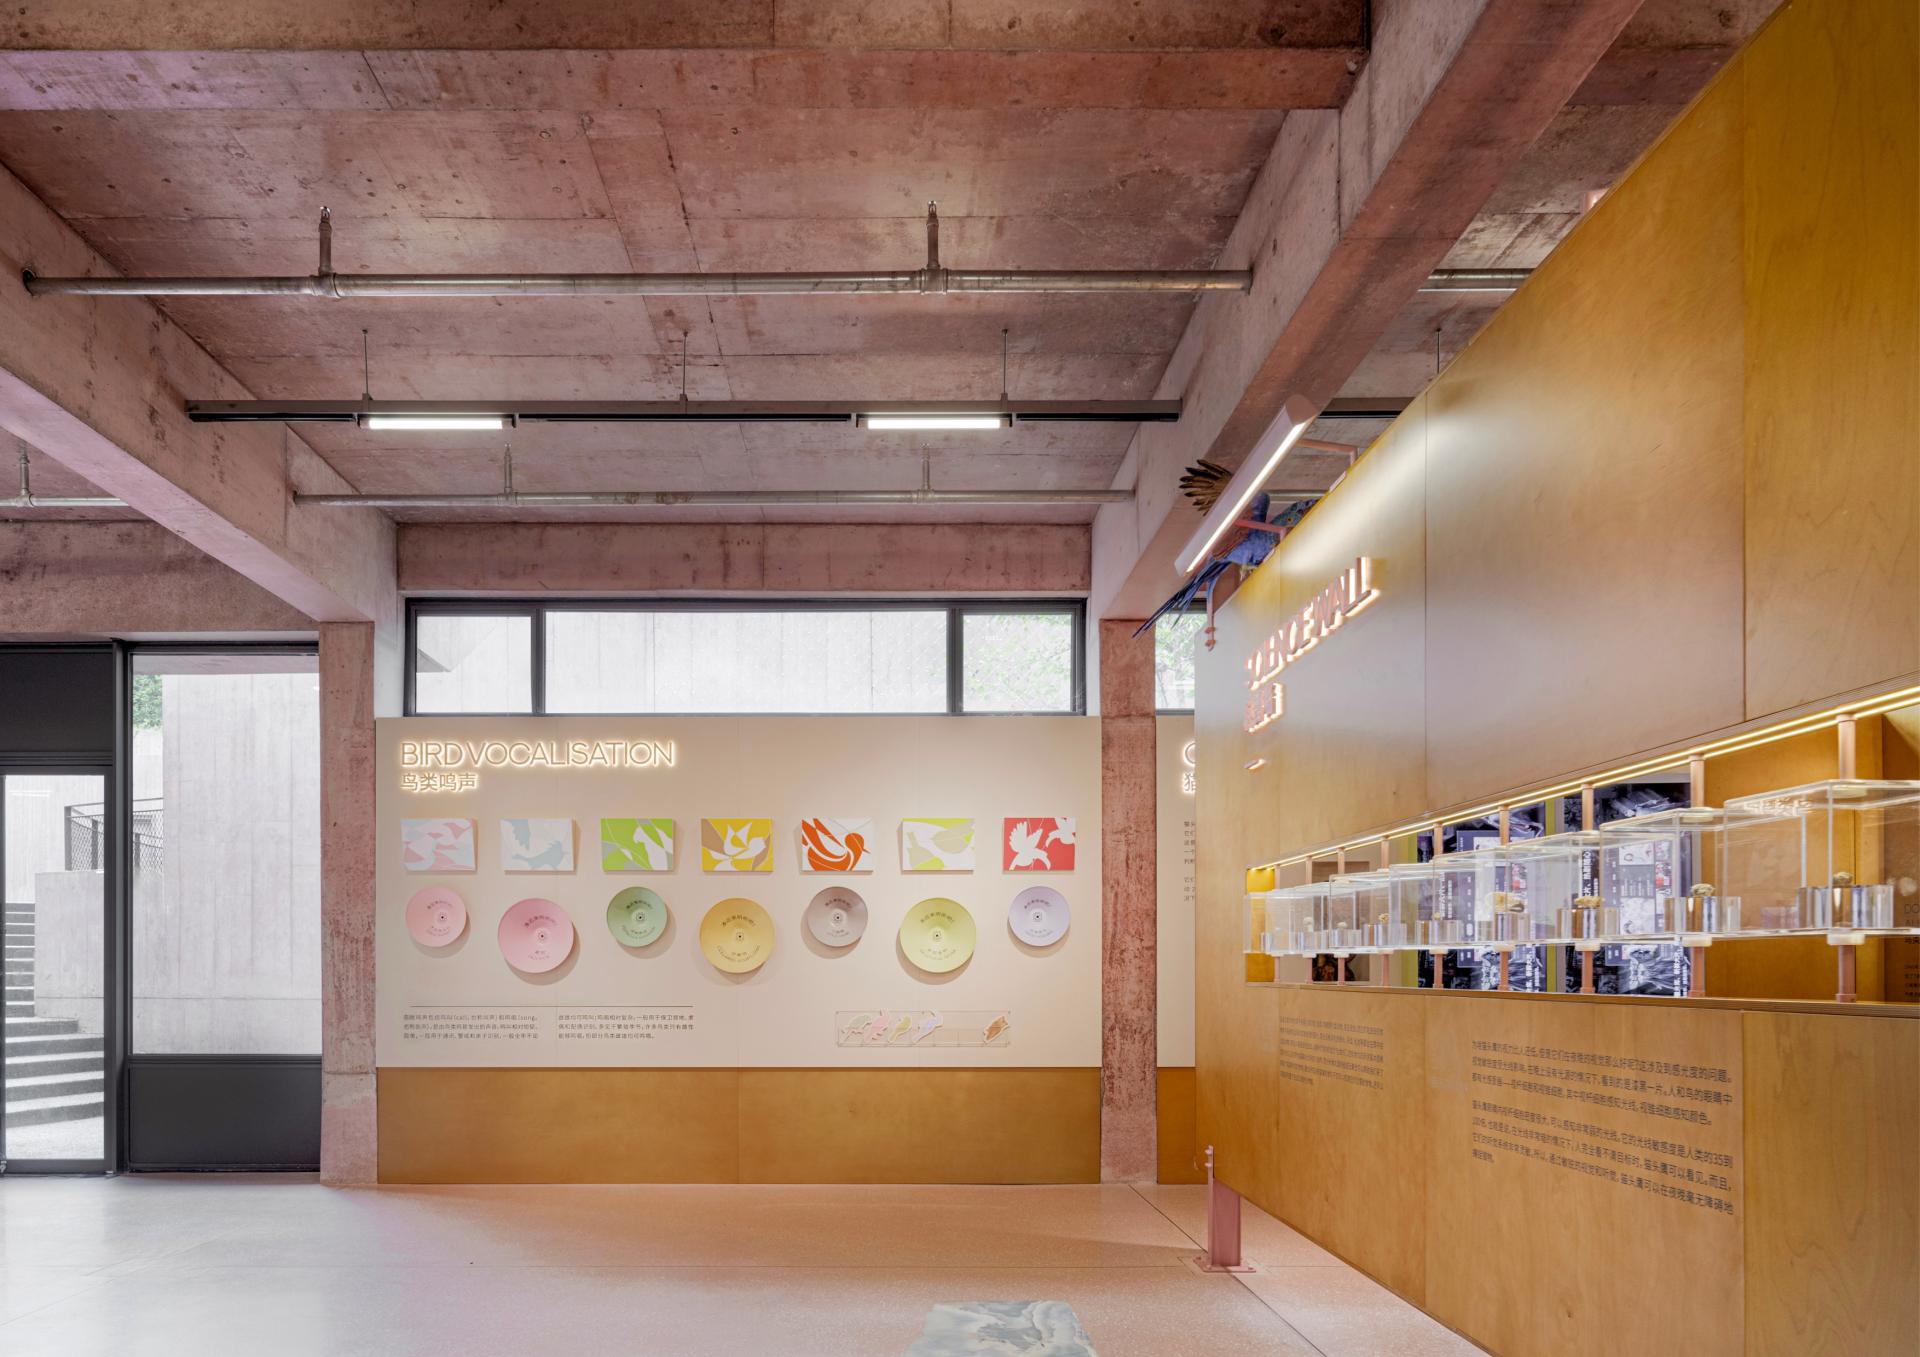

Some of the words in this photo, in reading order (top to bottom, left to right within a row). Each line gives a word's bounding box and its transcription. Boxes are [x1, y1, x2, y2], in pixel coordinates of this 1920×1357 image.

[400, 741, 464, 766] BIRD
[465, 741, 676, 767] VOCALISATION
[400, 772, 477, 792] 鸟类鸣声
